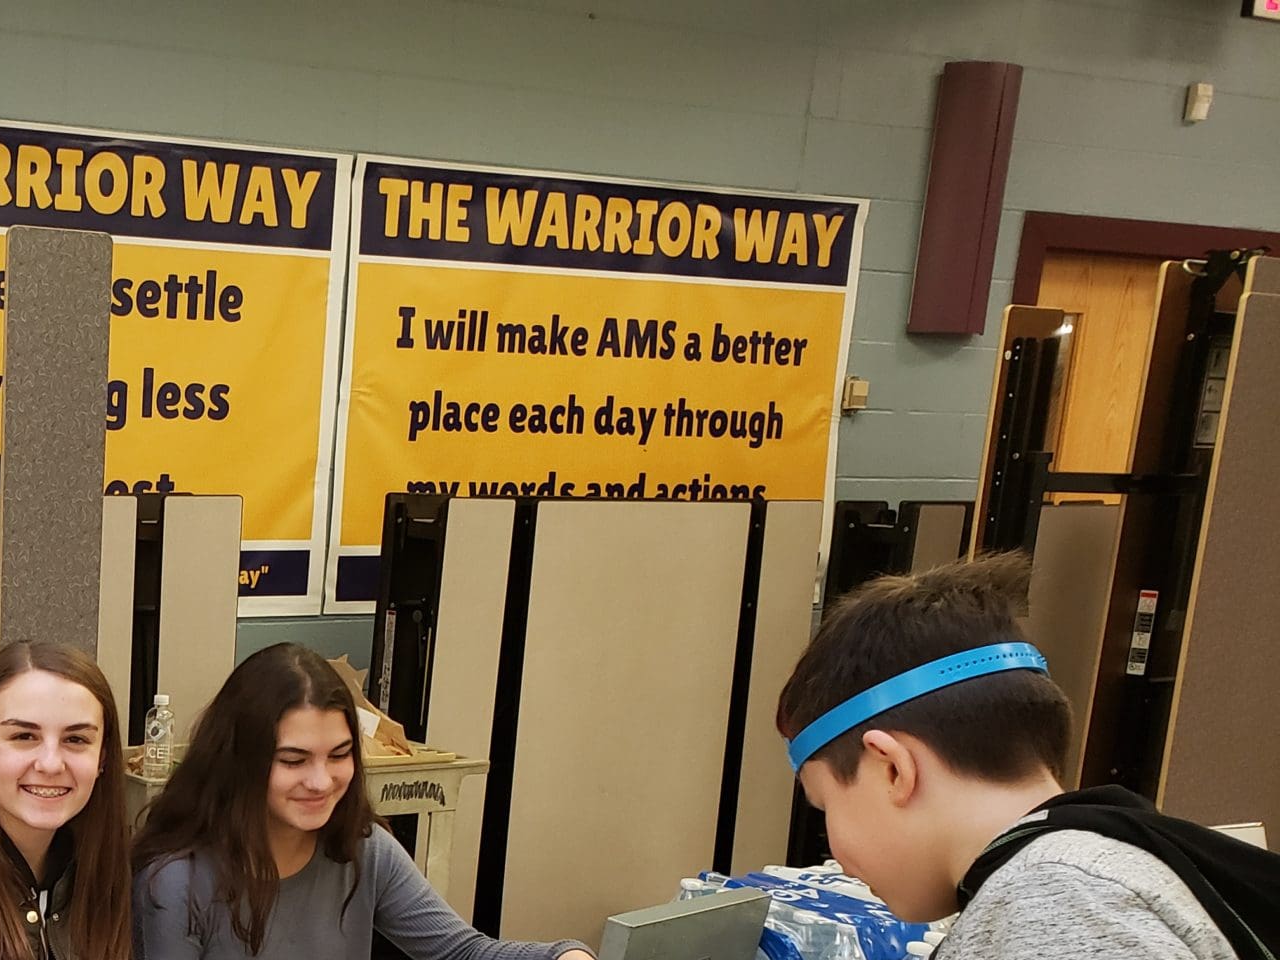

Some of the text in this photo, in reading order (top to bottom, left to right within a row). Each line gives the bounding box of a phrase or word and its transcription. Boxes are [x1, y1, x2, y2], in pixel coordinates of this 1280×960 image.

[180, 159, 321, 229] WAY
[379, 177, 845, 268] THE WARRIOR WAY
[111, 269, 244, 323] settle
[396, 306, 809, 366] I will make AMS a better
[141, 367, 231, 421] less
[408, 390, 784, 448] place each day through
[586, 472, 647, 500] and
[655, 473, 767, 501] actions
[238, 565, 270, 589] ay"
